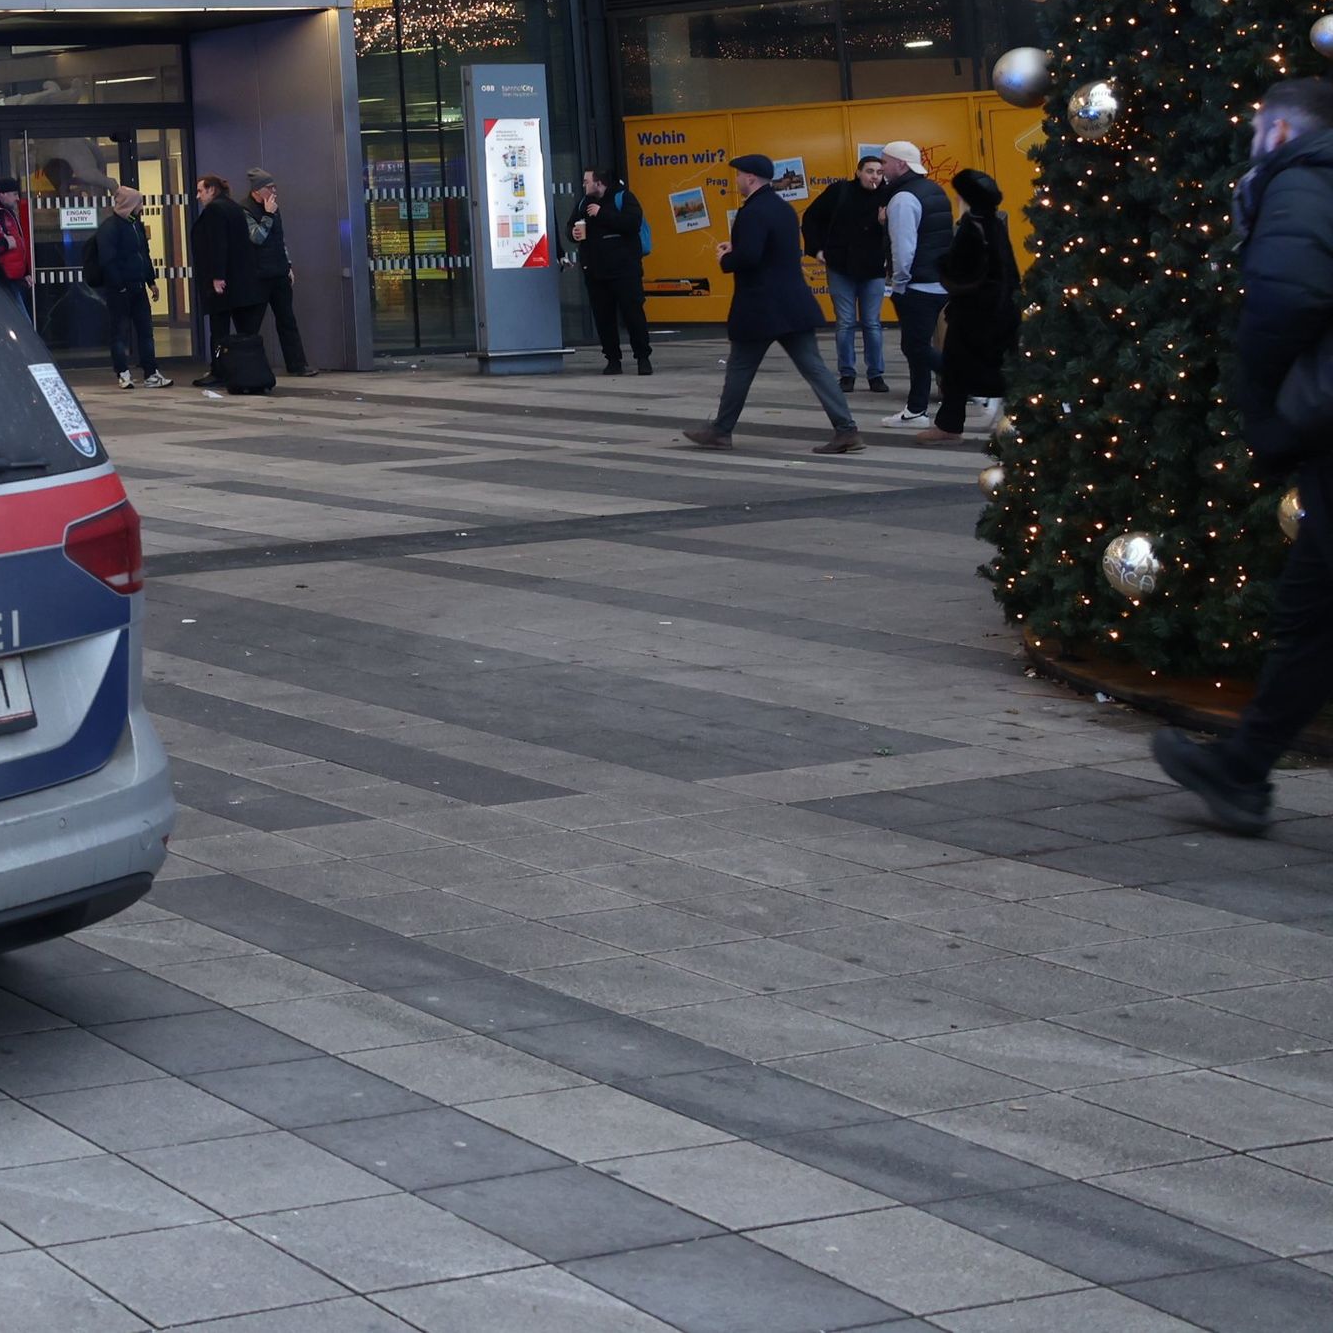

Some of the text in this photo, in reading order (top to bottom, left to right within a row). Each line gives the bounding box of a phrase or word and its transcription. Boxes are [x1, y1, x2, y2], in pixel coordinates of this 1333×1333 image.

[637, 131, 686, 146] Wohin
[638, 149, 726, 166] fahren wir?
[706, 177, 728, 187] Prag
